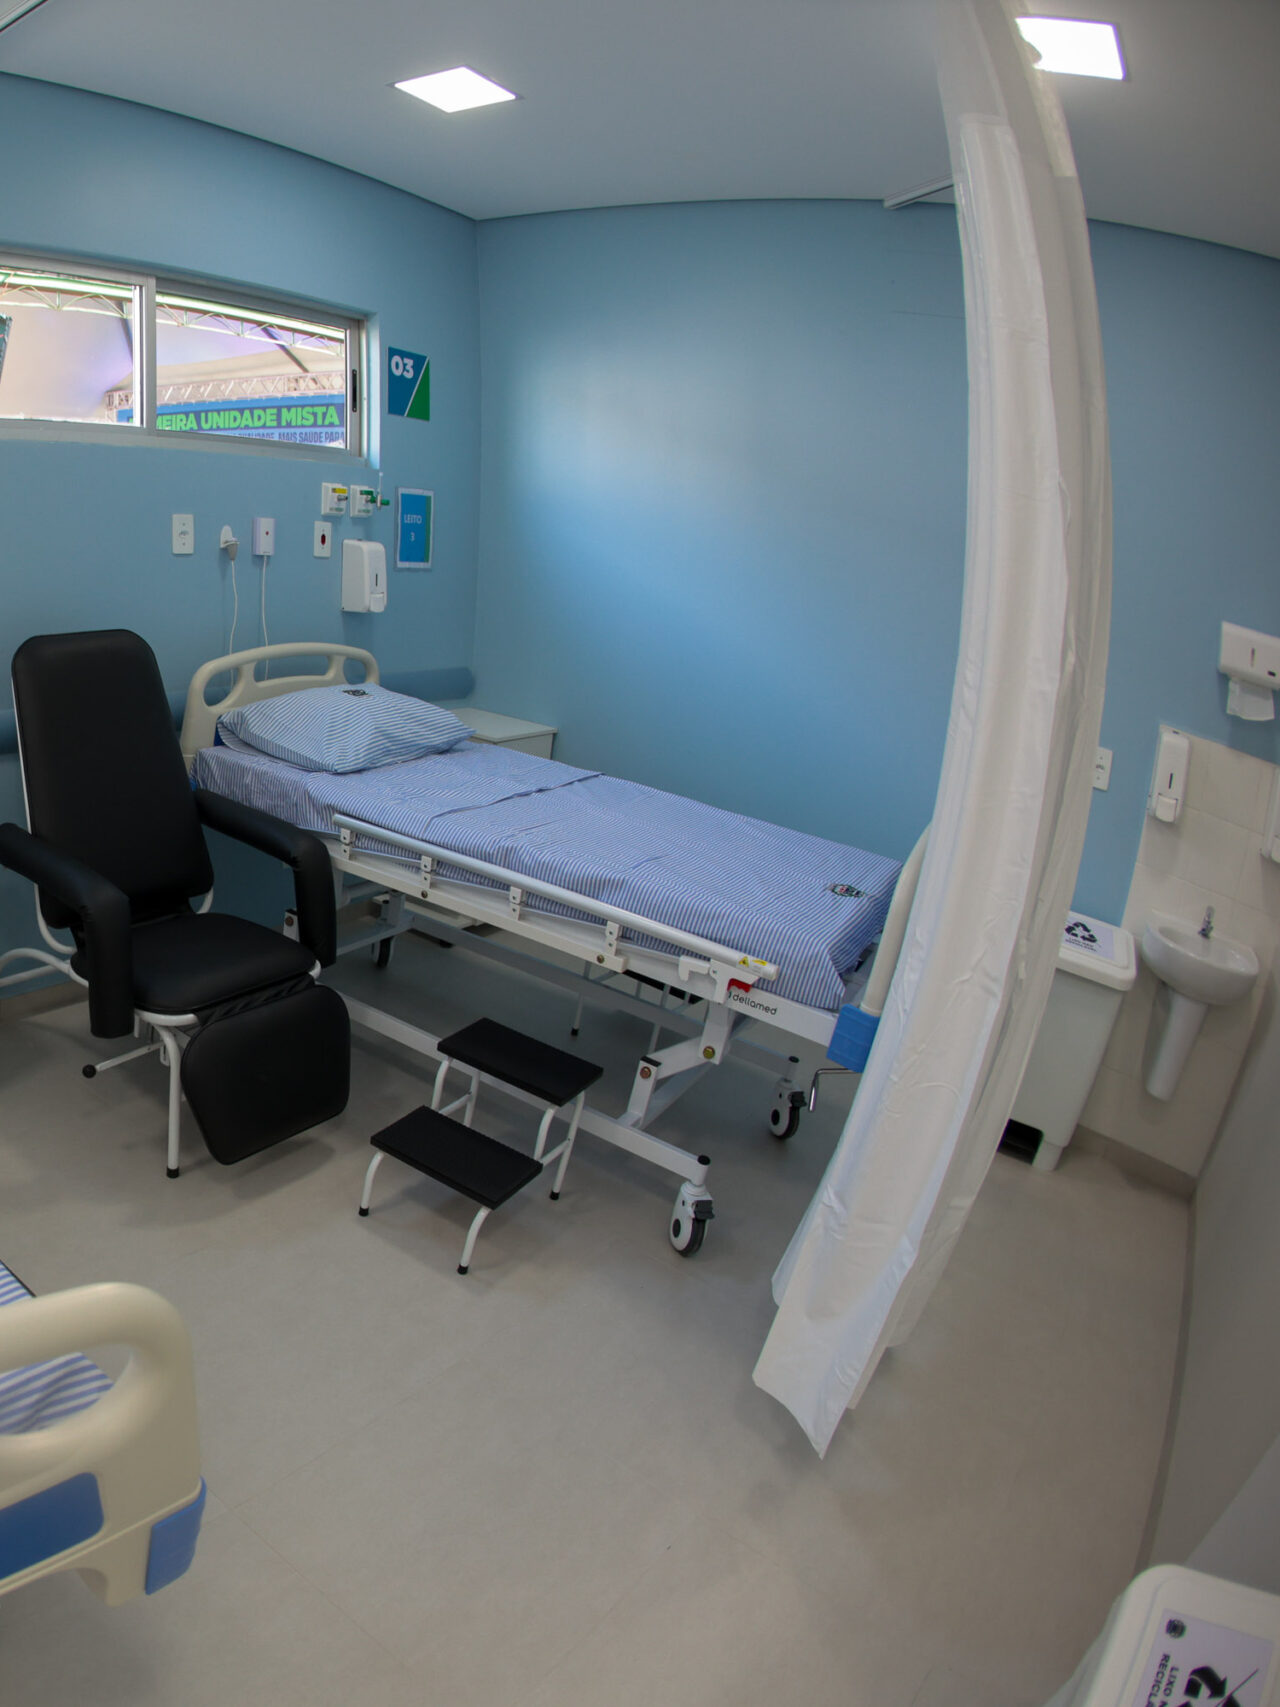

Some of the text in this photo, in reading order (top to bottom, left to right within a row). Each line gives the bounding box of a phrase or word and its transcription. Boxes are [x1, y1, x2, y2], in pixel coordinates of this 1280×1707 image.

[391, 355, 414, 379] 03
[200, 408, 277, 430] UNIDADE
[281, 405, 340, 427] MISTA
[404, 514, 422, 524] LEITO
[732, 994, 777, 1015] dellamed
[1163, 1666, 1179, 1697] LIXO
